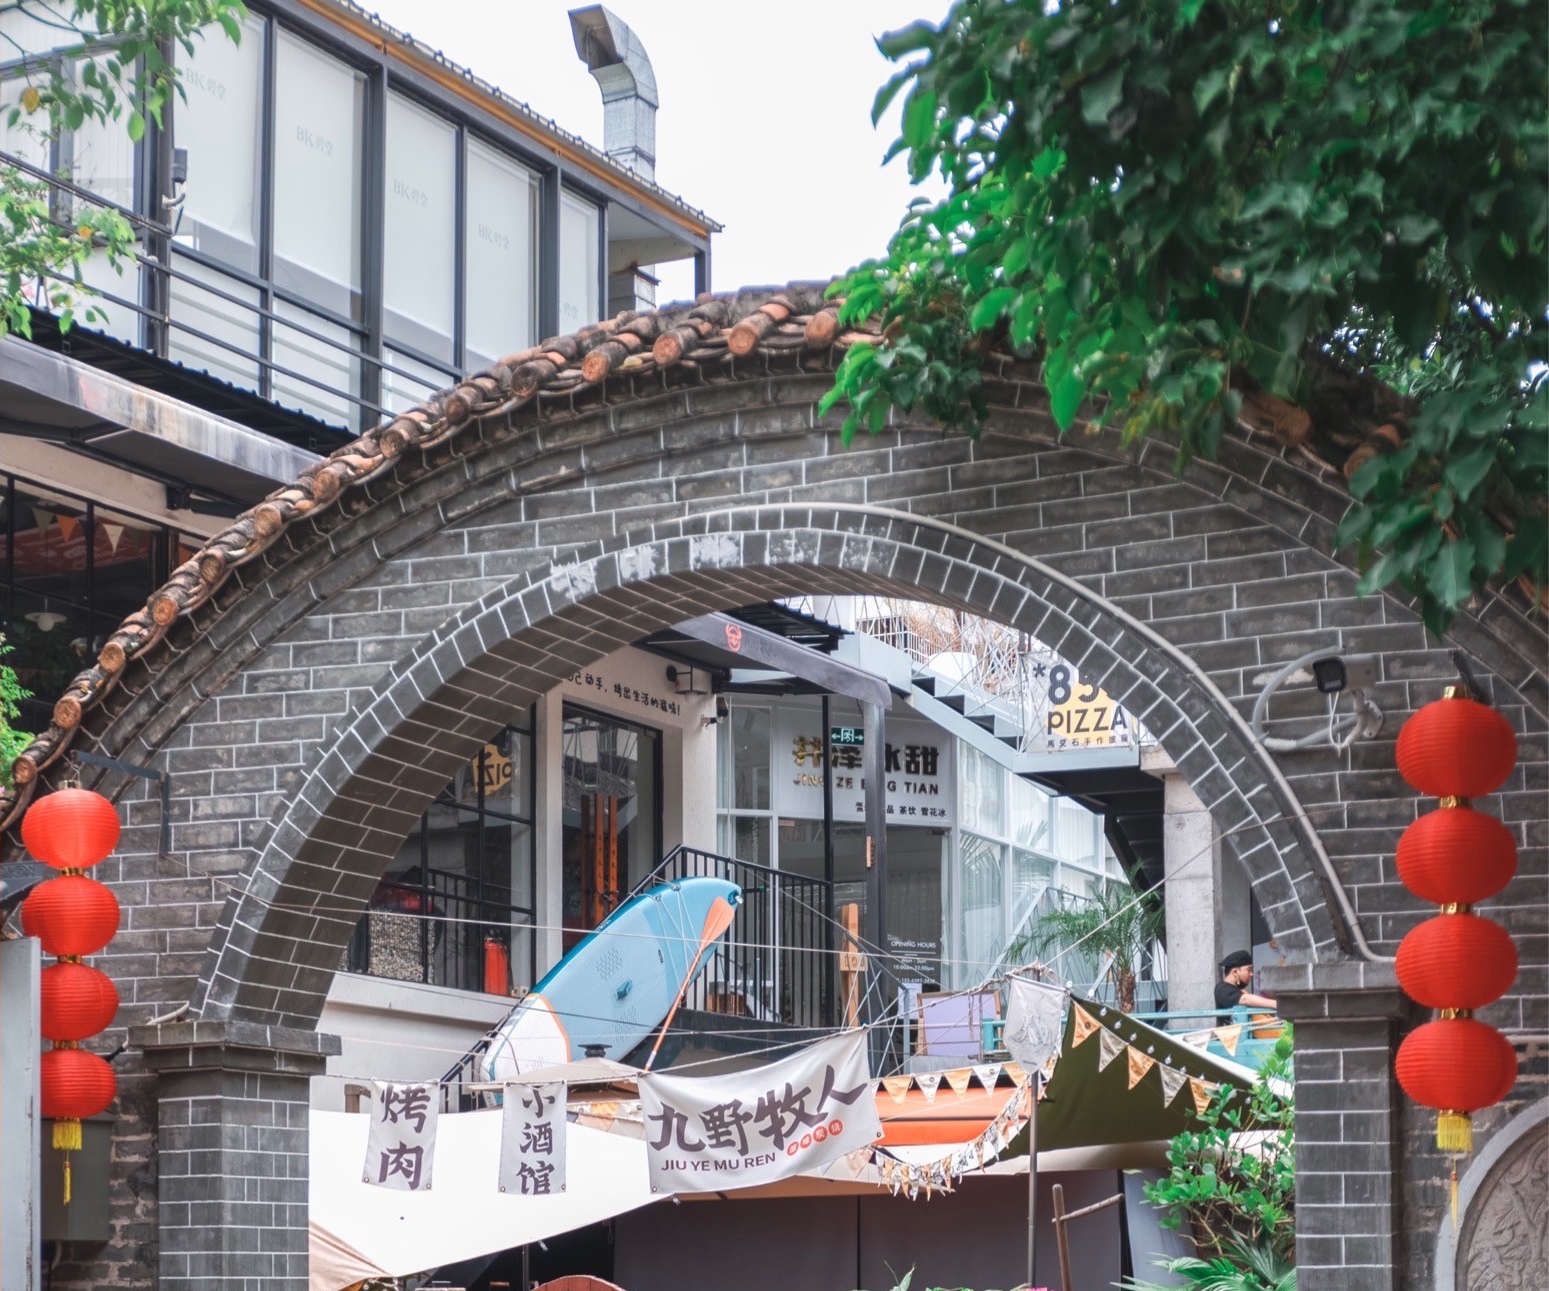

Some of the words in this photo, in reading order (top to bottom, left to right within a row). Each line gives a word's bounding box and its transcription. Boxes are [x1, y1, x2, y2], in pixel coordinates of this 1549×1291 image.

[1048, 705, 1128, 735] PIZZA
[904, 781, 939, 795] TIAN
[379, 1084, 431, 1191] 烤肉
[516, 1085, 555, 1196] 小酒馆
[648, 1064, 868, 1157] 九野牧人
[661, 1159, 687, 1171] JIU
[691, 1160, 710, 1171] YE
[714, 1159, 740, 1171] MU
[744, 1152, 777, 1169] REN
